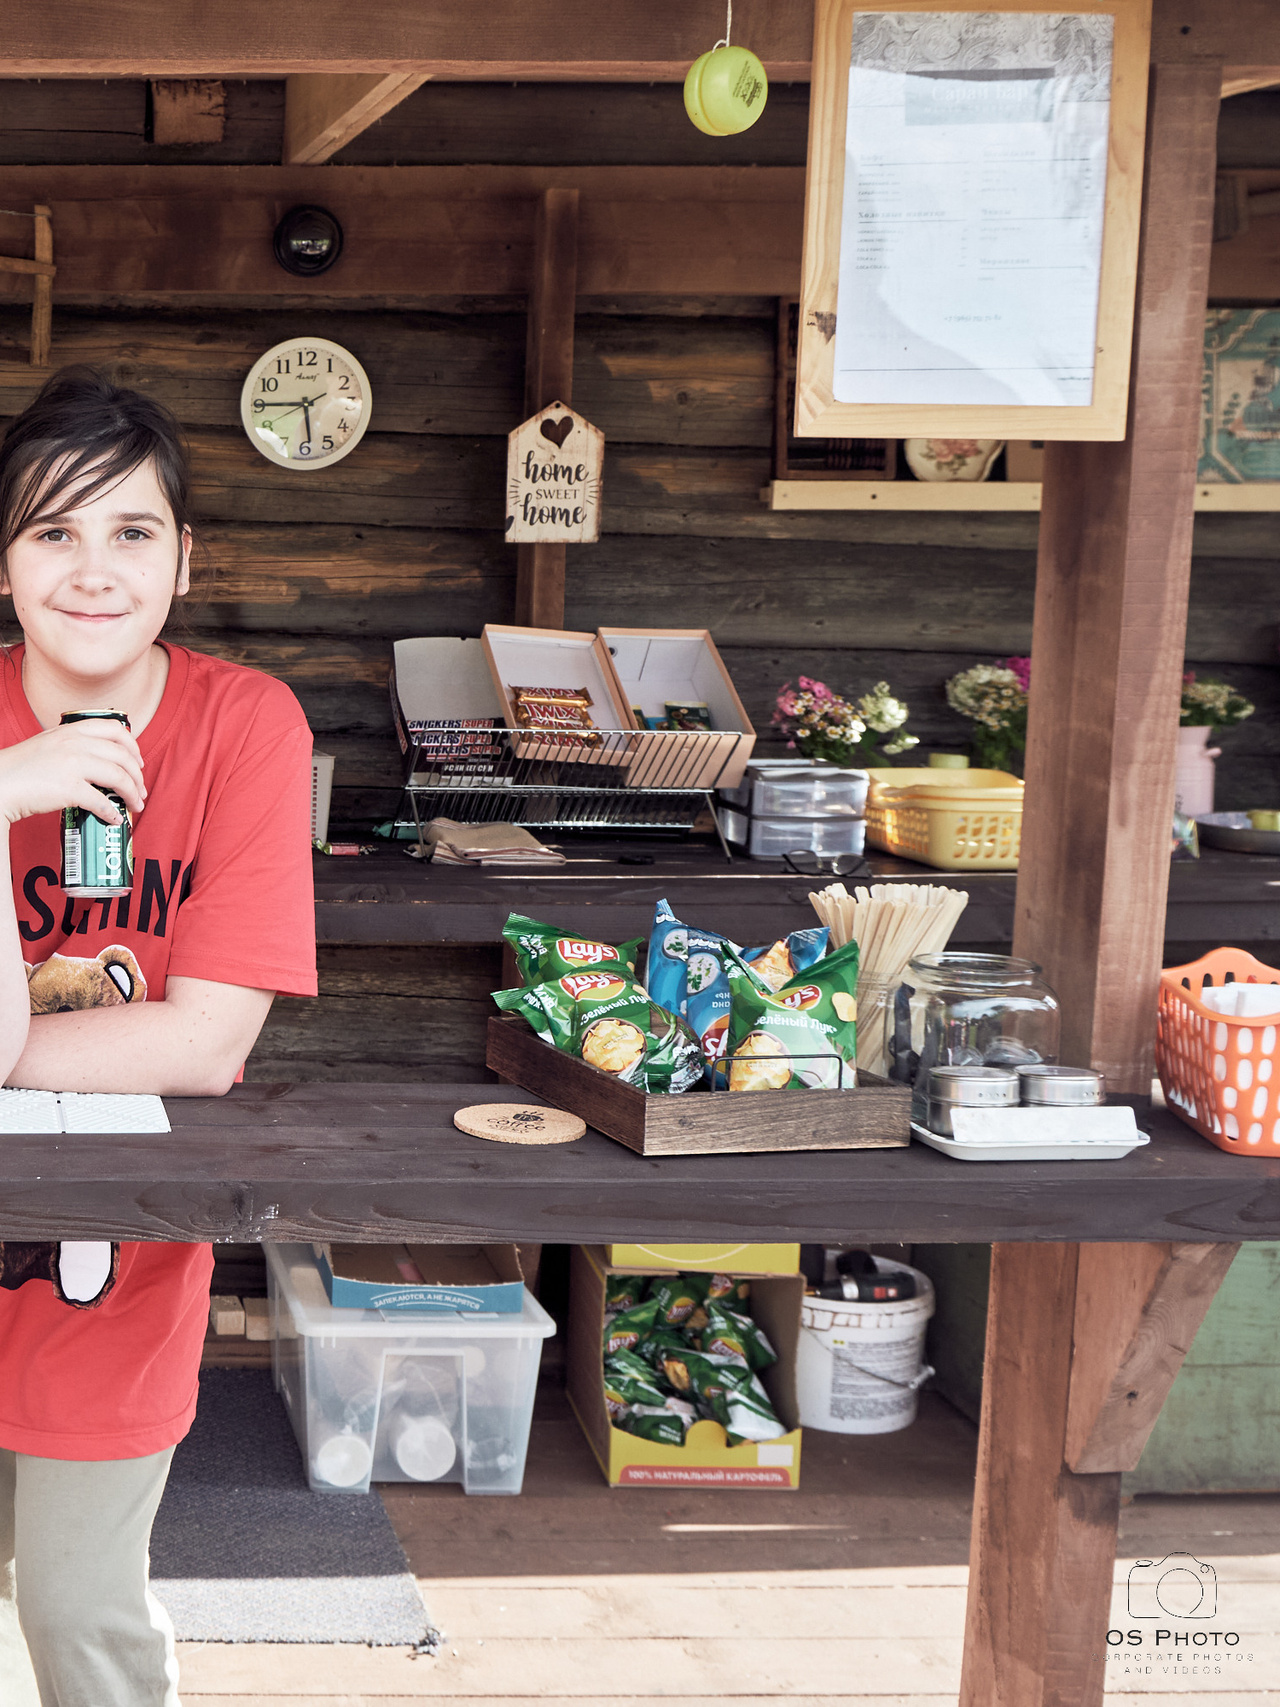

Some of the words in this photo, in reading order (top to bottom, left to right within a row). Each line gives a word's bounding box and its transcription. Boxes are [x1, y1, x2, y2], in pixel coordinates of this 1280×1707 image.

[276, 358, 291, 374] 11
[297, 351, 318, 366] 12
[326, 358, 333, 373] 1
[261, 377, 278, 392] 10
[338, 375, 350, 390] 2
[253, 398, 265, 413] 9
[337, 418, 349, 433] 4
[299, 440, 311, 456] 6
[321, 435, 334, 450] 5
[521, 450, 589, 485] home
[535, 489, 580, 500] SWEET
[519, 492, 587, 528] home
[521, 702, 581, 720] TWIX
[409, 719, 462, 729] SNICKERS
[465, 719, 494, 729] SUPER
[563, 939, 617, 964] Lay's
[565, 973, 619, 997] Lay's
[373, 1293, 426, 1308] ЗАПЕКАЮТСЯ,
[444, 1295, 481, 1310] ЖАРЯТСЯ
[628, 1470, 653, 1480] 100%
[654, 1470, 725, 1481] НАТУРАЛЬНЫЙ
[726, 1472, 783, 1482] КАРТОФЕЛЬ
